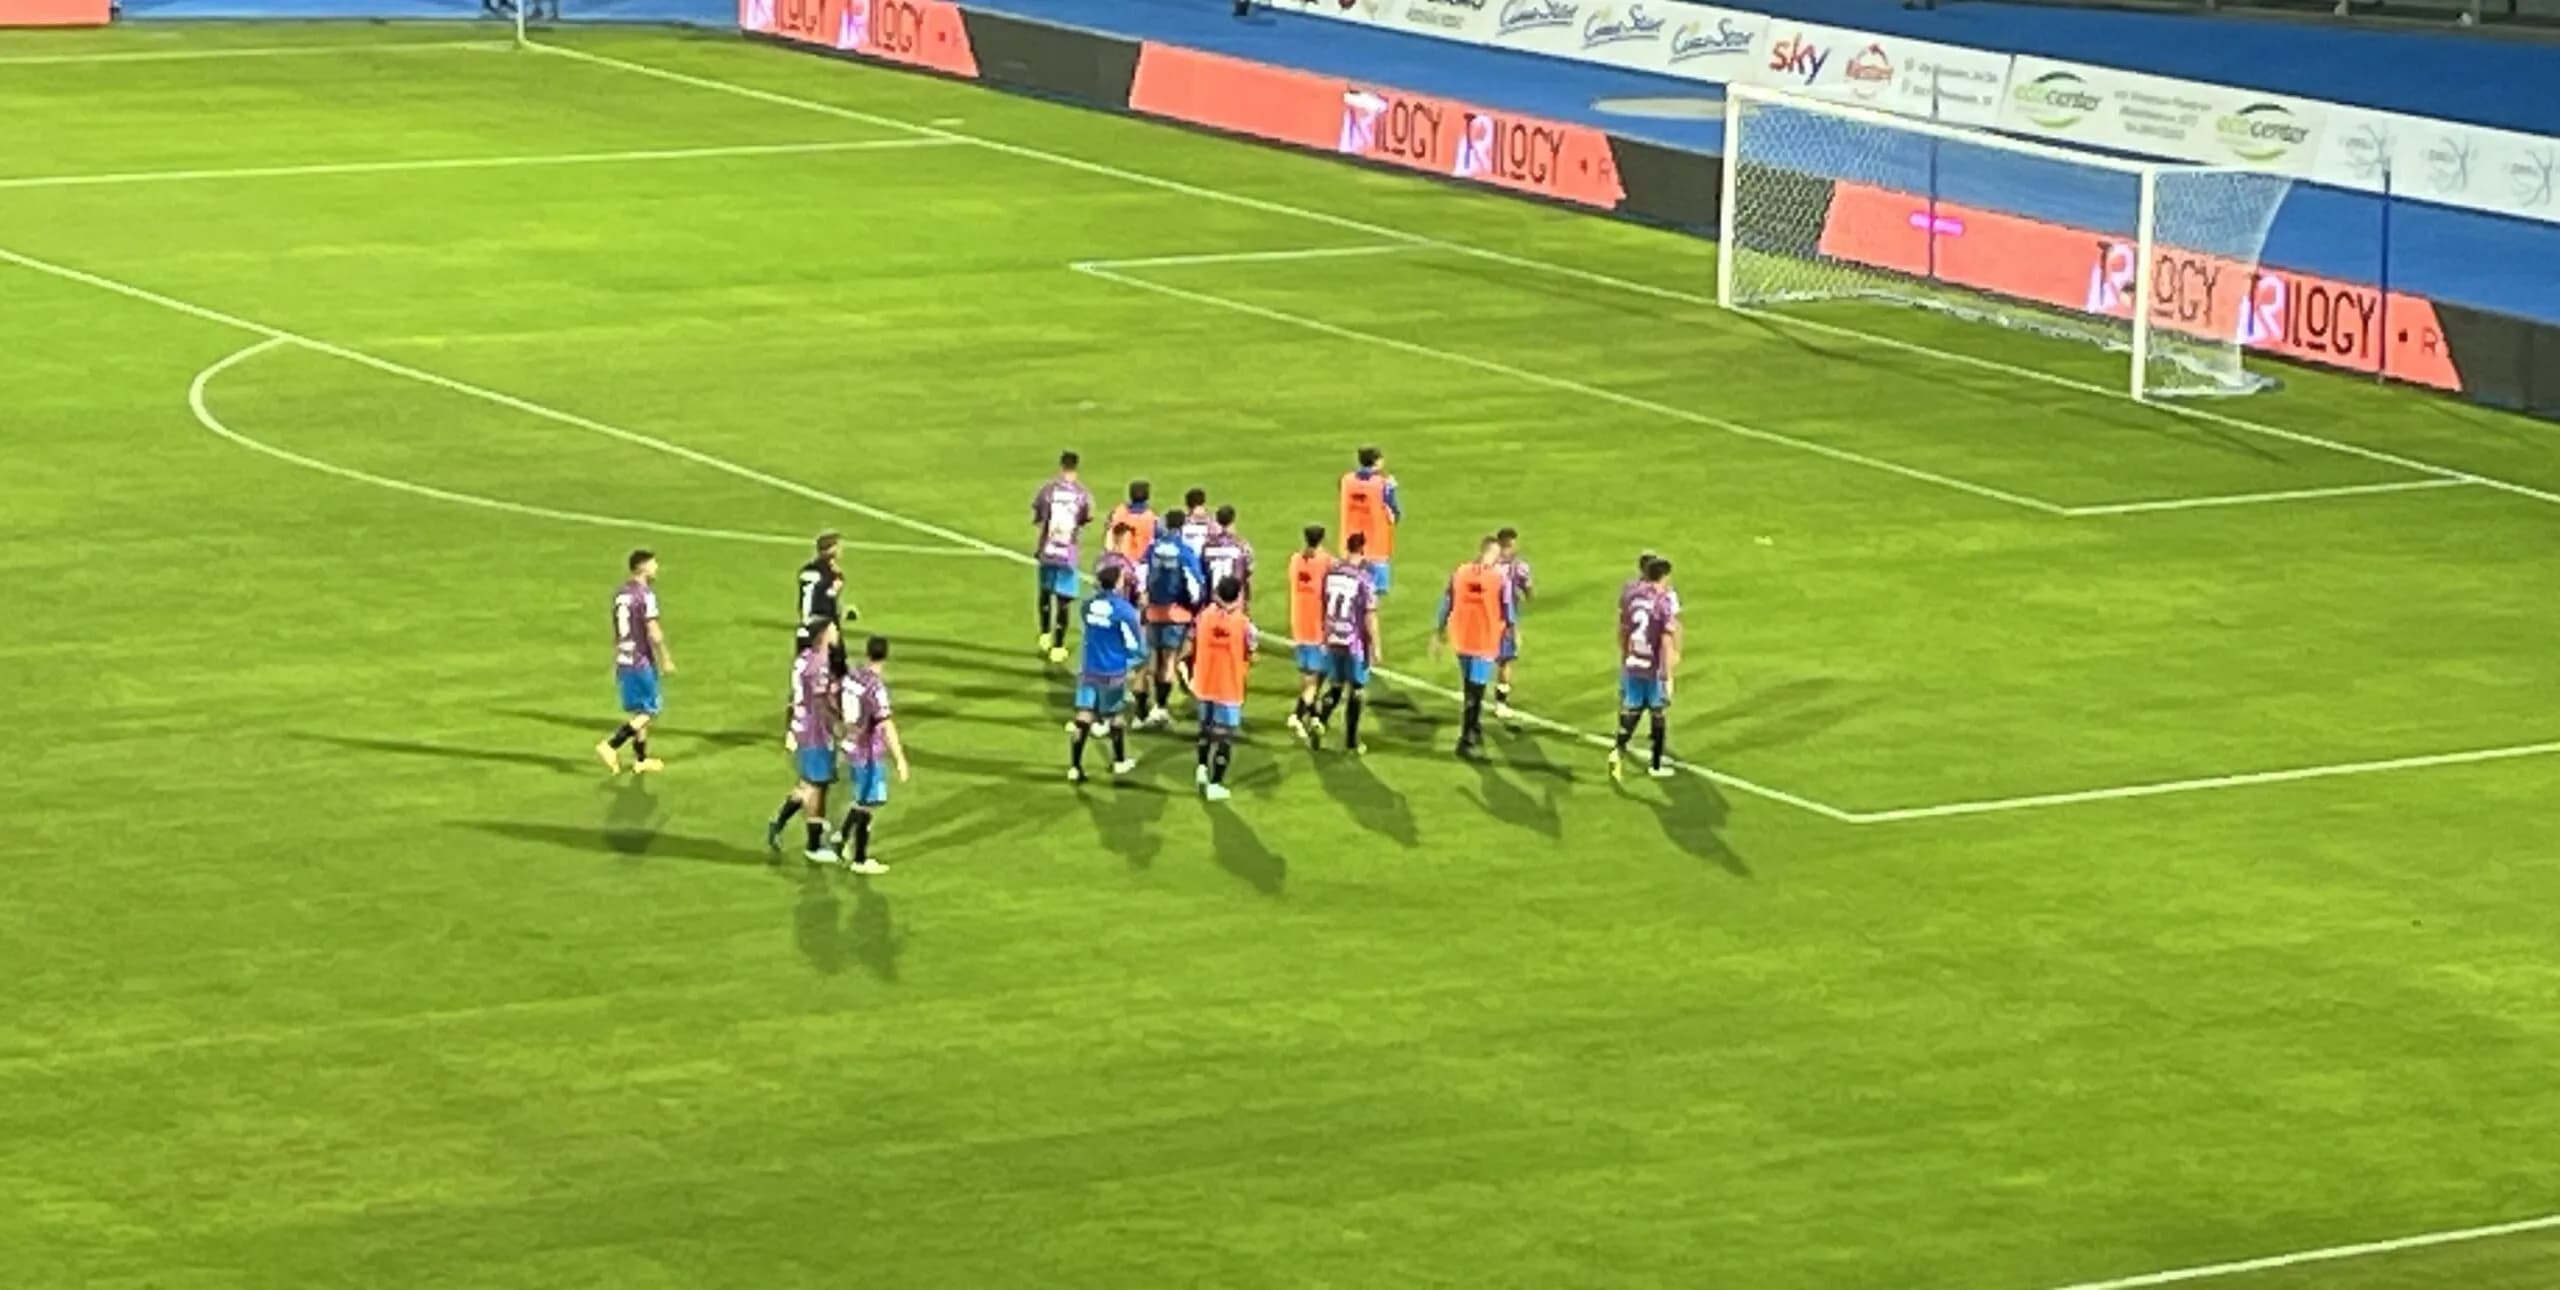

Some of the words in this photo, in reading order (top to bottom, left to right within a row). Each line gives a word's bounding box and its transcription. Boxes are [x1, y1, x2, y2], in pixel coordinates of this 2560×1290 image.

[1769, 34, 1830, 86] sky
[1456, 113, 1565, 186] TRILOGY
[2089, 241, 2222, 327] TROGY
[2243, 272, 2376, 359] TRILOGY
